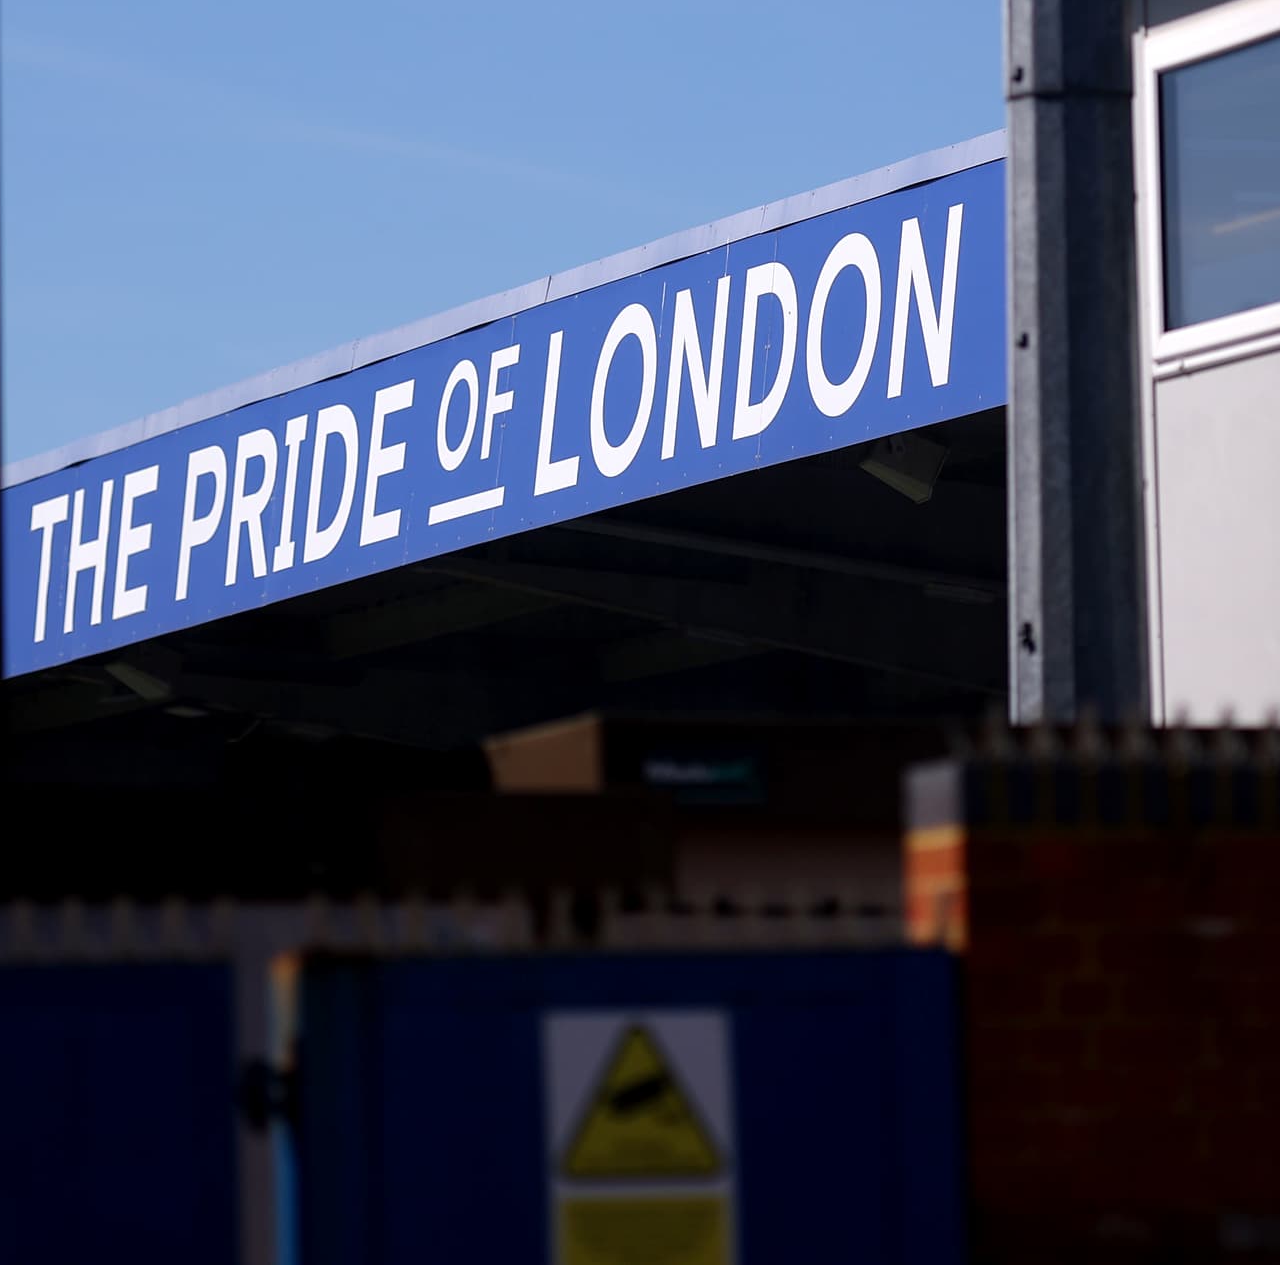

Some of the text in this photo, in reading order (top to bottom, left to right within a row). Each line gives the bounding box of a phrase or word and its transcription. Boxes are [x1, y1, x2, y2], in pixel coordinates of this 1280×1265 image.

[30, 203, 964, 643] THE PRIDE OF LONDON
